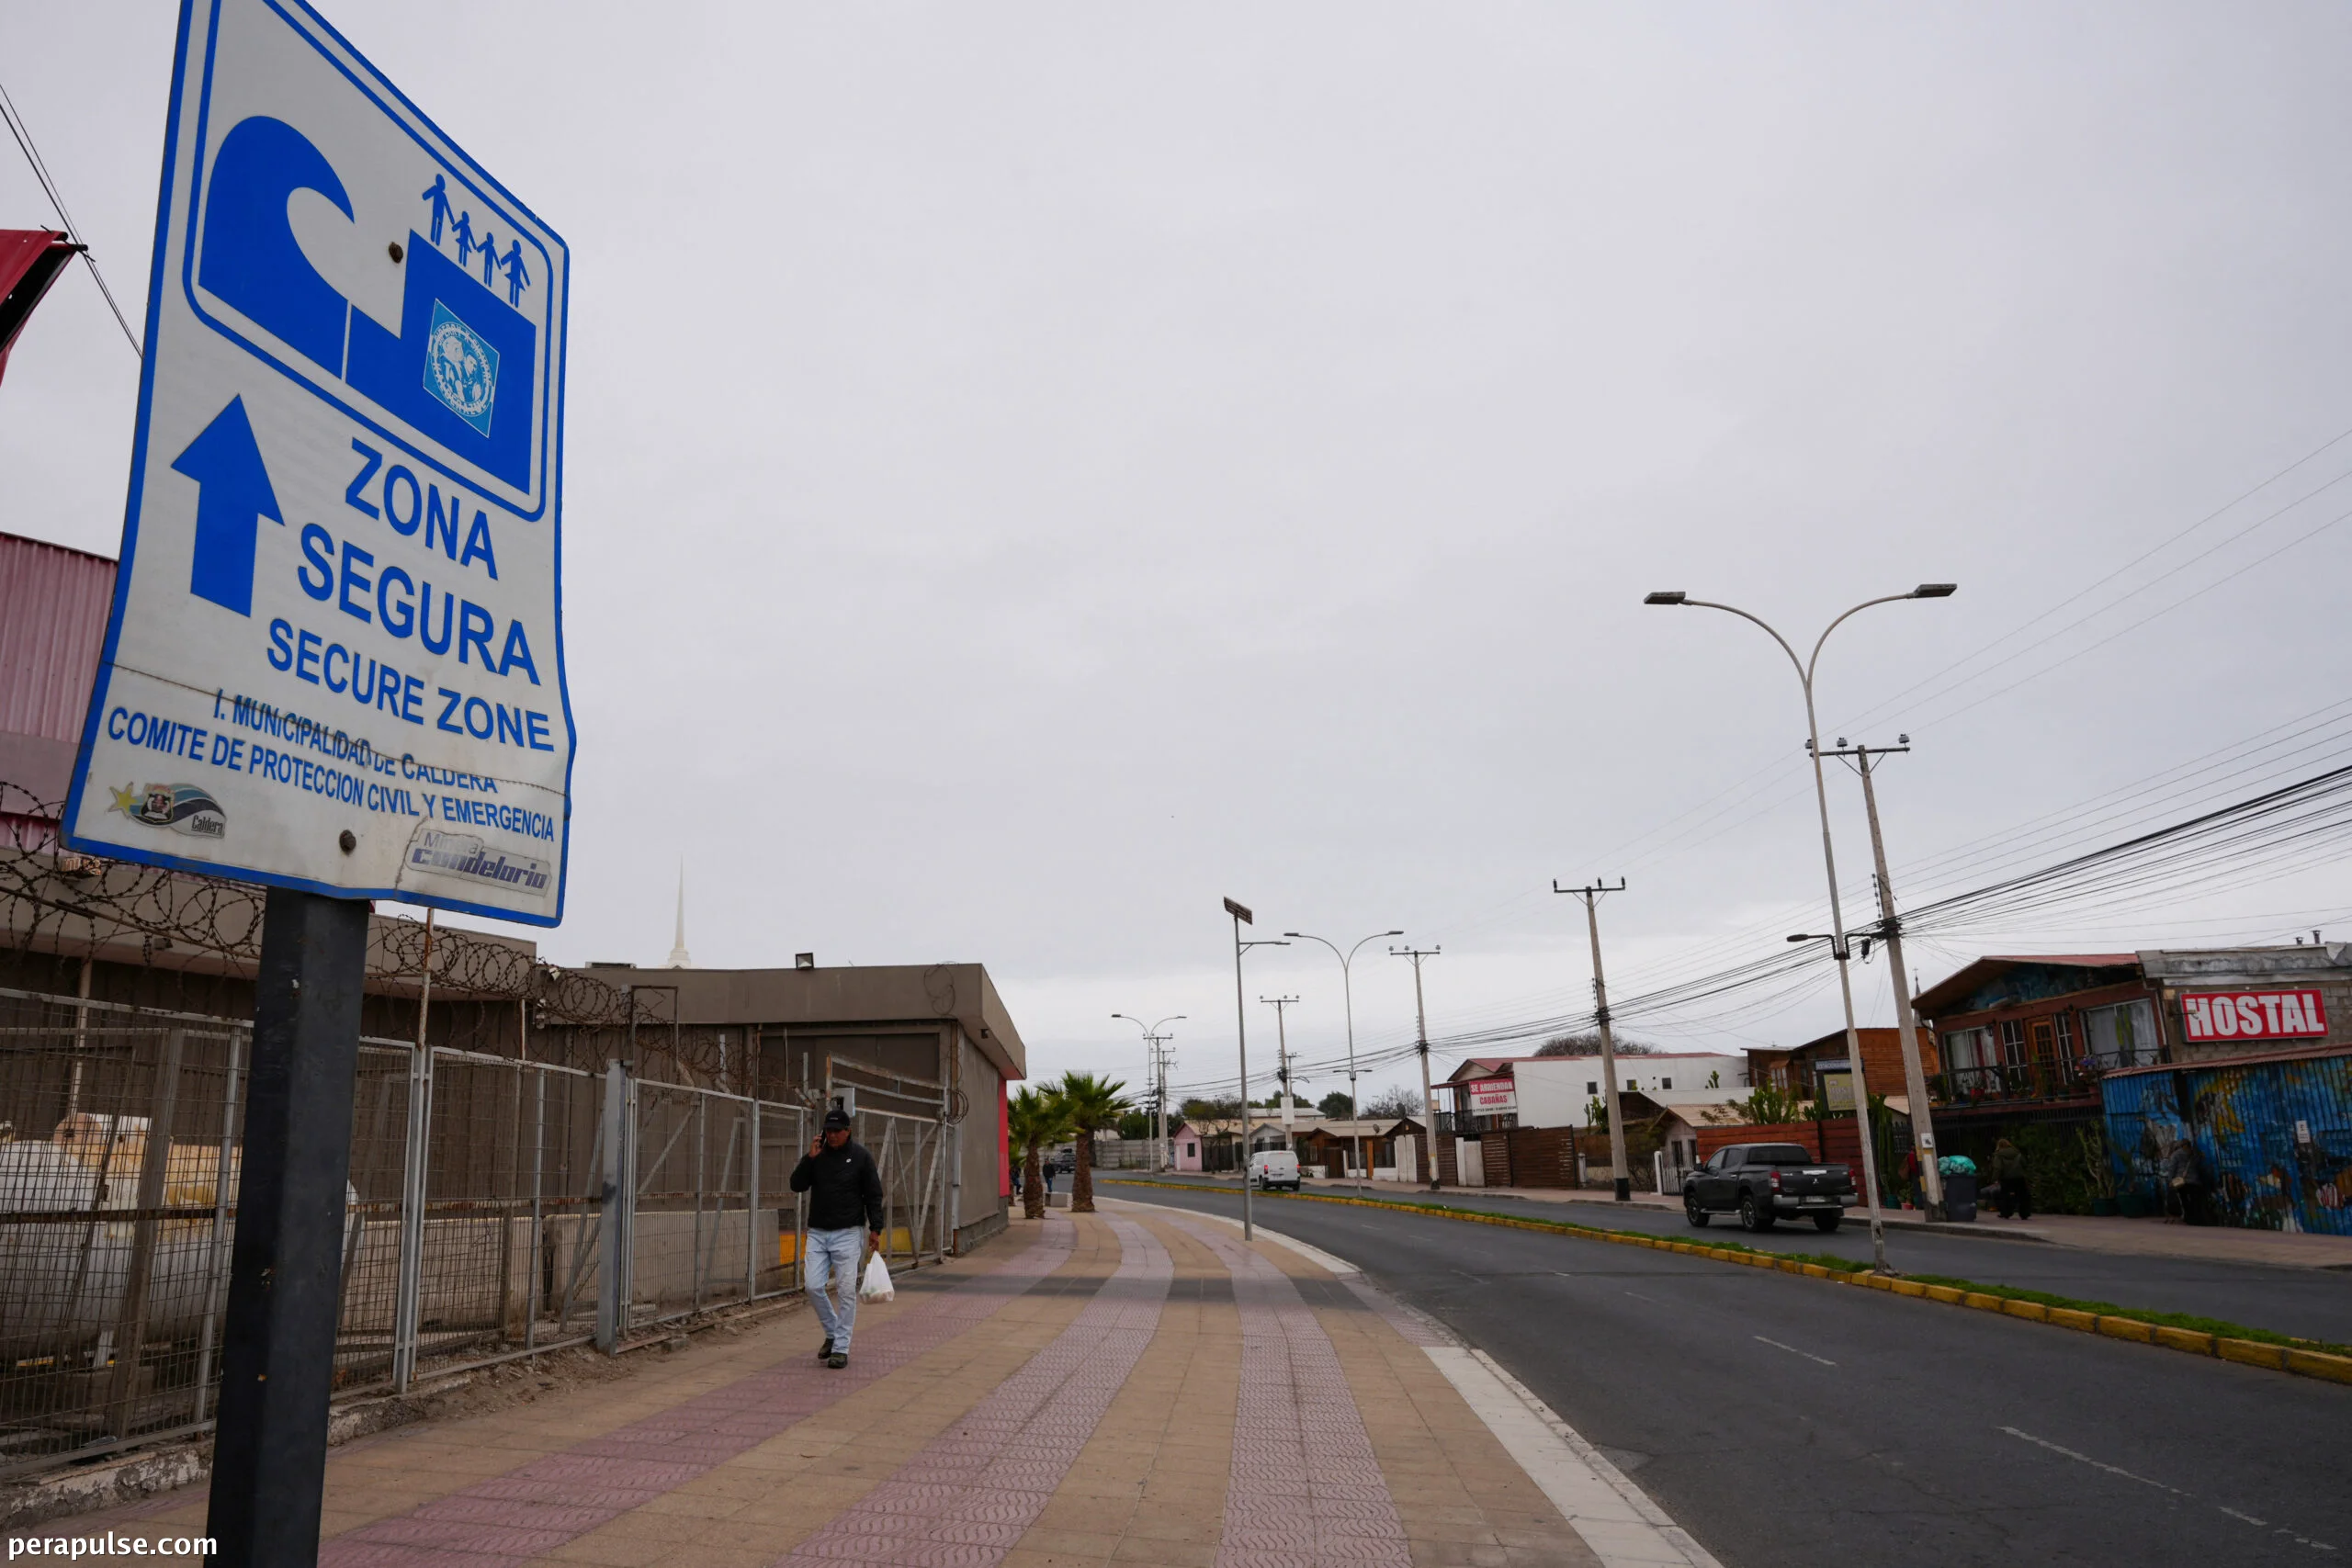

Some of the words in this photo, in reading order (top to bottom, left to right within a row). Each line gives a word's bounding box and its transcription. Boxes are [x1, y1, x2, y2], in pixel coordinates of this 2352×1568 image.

[345, 438, 498, 581] ZONA
[298, 524, 540, 685] SEGURA
[267, 619, 424, 726] SECURE
[437, 689, 555, 752] ZONE
[107, 706, 209, 761] COMITE
[210, 734, 245, 772] DE
[249, 745, 365, 806] PROTECCION
[368, 784, 421, 817] CIVIL
[424, 794, 438, 818] Y
[442, 796, 555, 841] EMERGENCIA
[213, 688, 226, 721] I.
[232, 694, 372, 768] MUNICIPALIDAD
[374, 755, 397, 777] DE
[402, 753, 499, 794] CALDERA
[191, 814, 224, 836] Caldera
[2185, 993, 2325, 1037] HOSTAL
[1470, 1084, 1479, 1093] SE
[1479, 1093, 1508, 1105] CABAÑAS
